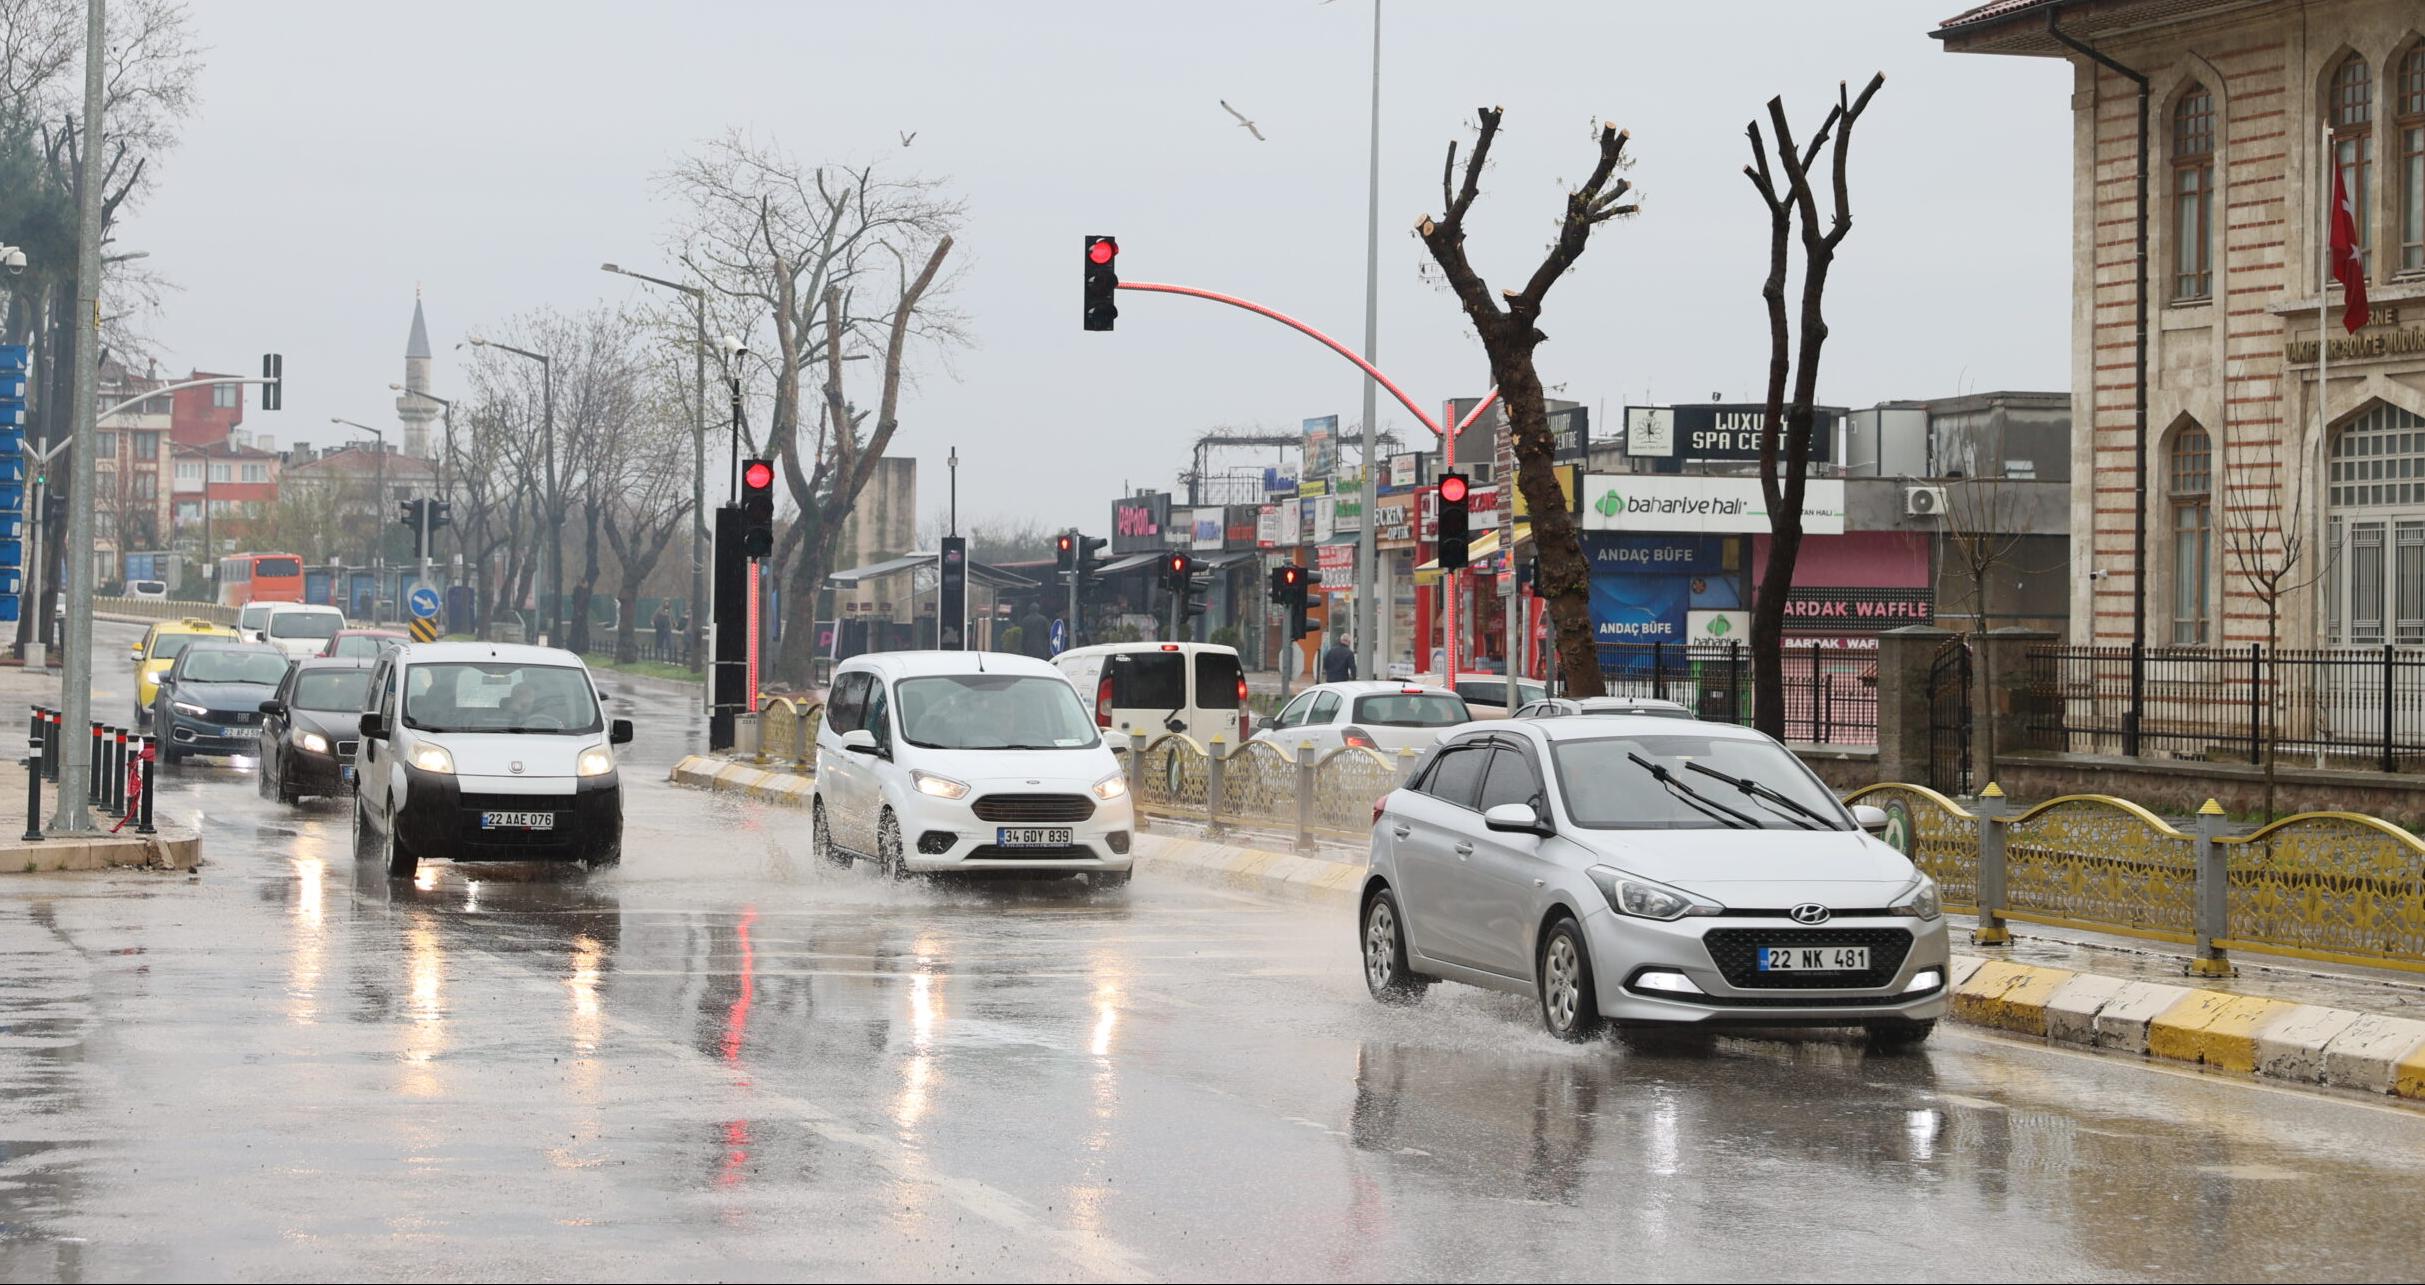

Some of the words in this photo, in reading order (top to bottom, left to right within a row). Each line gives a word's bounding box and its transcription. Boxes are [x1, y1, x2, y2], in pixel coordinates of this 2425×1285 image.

[2367, 308, 2393, 326] RNE
[1715, 412, 1789, 432] LUXUY
[1692, 431, 1731, 450] SPA
[1738, 432, 1813, 451] CET
[1628, 495, 1709, 515] bahariye
[1598, 548, 1650, 564] ANDAÇ
[1653, 546, 1694, 561] BÜFE
[1783, 601, 1848, 617] ARDAK
[1856, 601, 1928, 618] WAFFLE
[1600, 622, 1640, 637] ANDAÇ
[1641, 620, 1672, 634] BÜFE
[1785, 638, 1839, 648] BARDAK
[488, 813, 503, 825] 22
[506, 813, 527, 825] AAE
[530, 814, 552, 826] 076
[1005, 830, 1020, 843] 34
[1023, 830, 1044, 843] GDY
[1048, 830, 1069, 843] 839
[1769, 950, 1791, 969] 22
[1802, 949, 1824, 969] NK
[1834, 949, 1865, 968] 481
